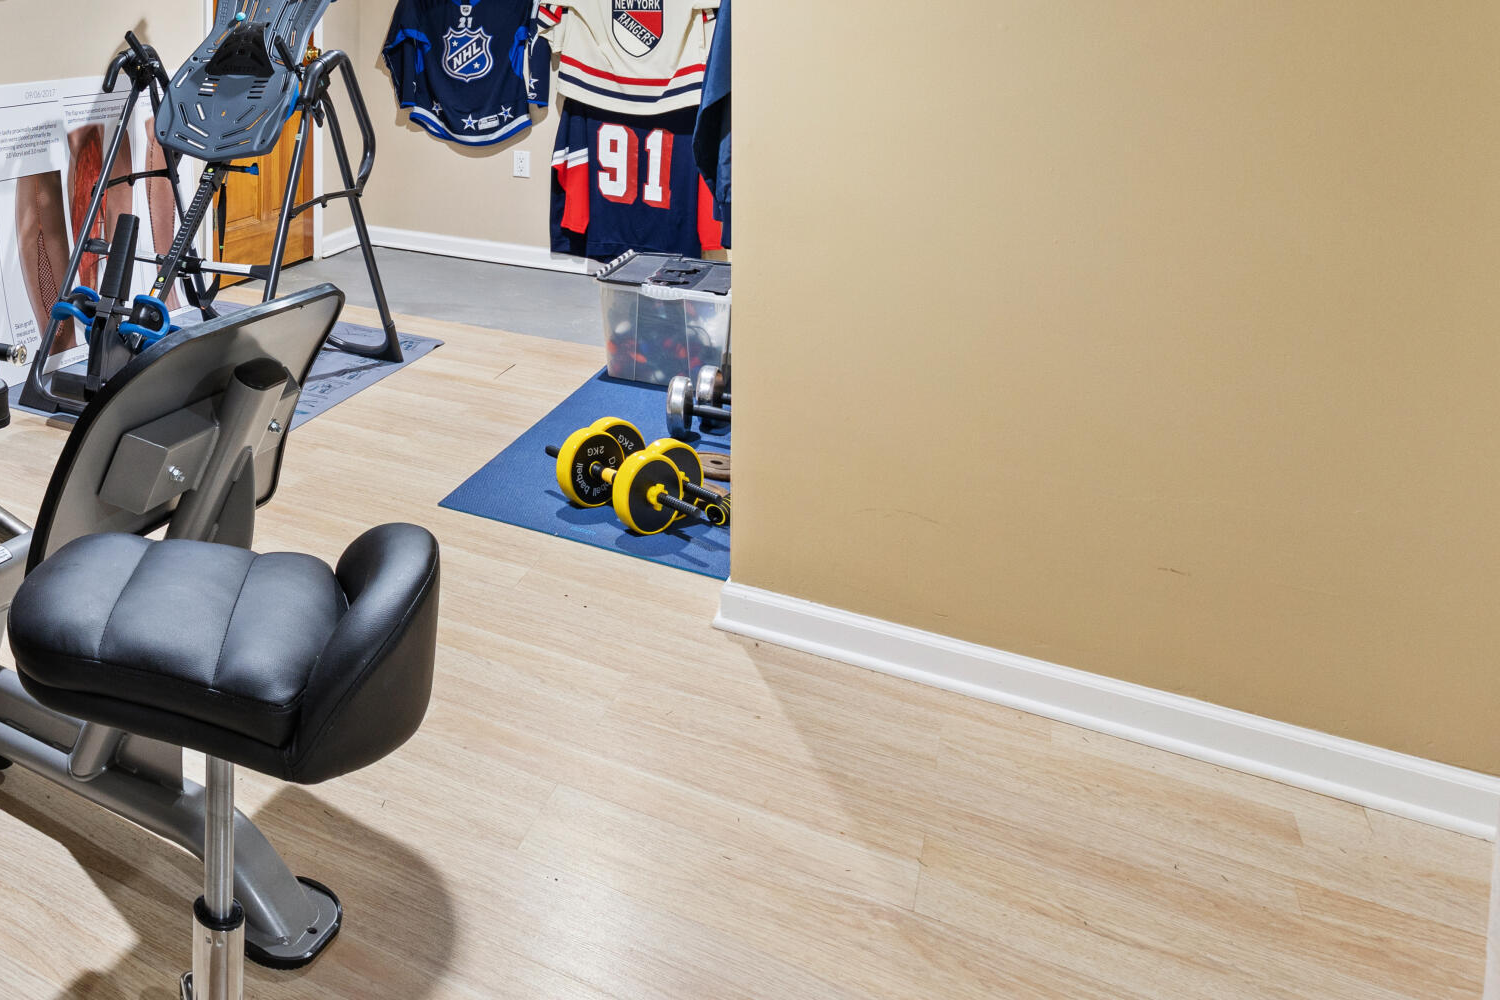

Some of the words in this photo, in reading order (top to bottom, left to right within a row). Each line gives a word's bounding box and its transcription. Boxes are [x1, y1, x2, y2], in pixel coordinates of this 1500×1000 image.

[458, 16, 473, 29] 21
[617, 12, 656, 46] RANGERS
[452, 42, 482, 69] NHL
[597, 122, 674, 210] 91
[587, 445, 605, 457] 2KG
[617, 434, 635, 450] 2KG
[576, 462, 590, 495] barbell
